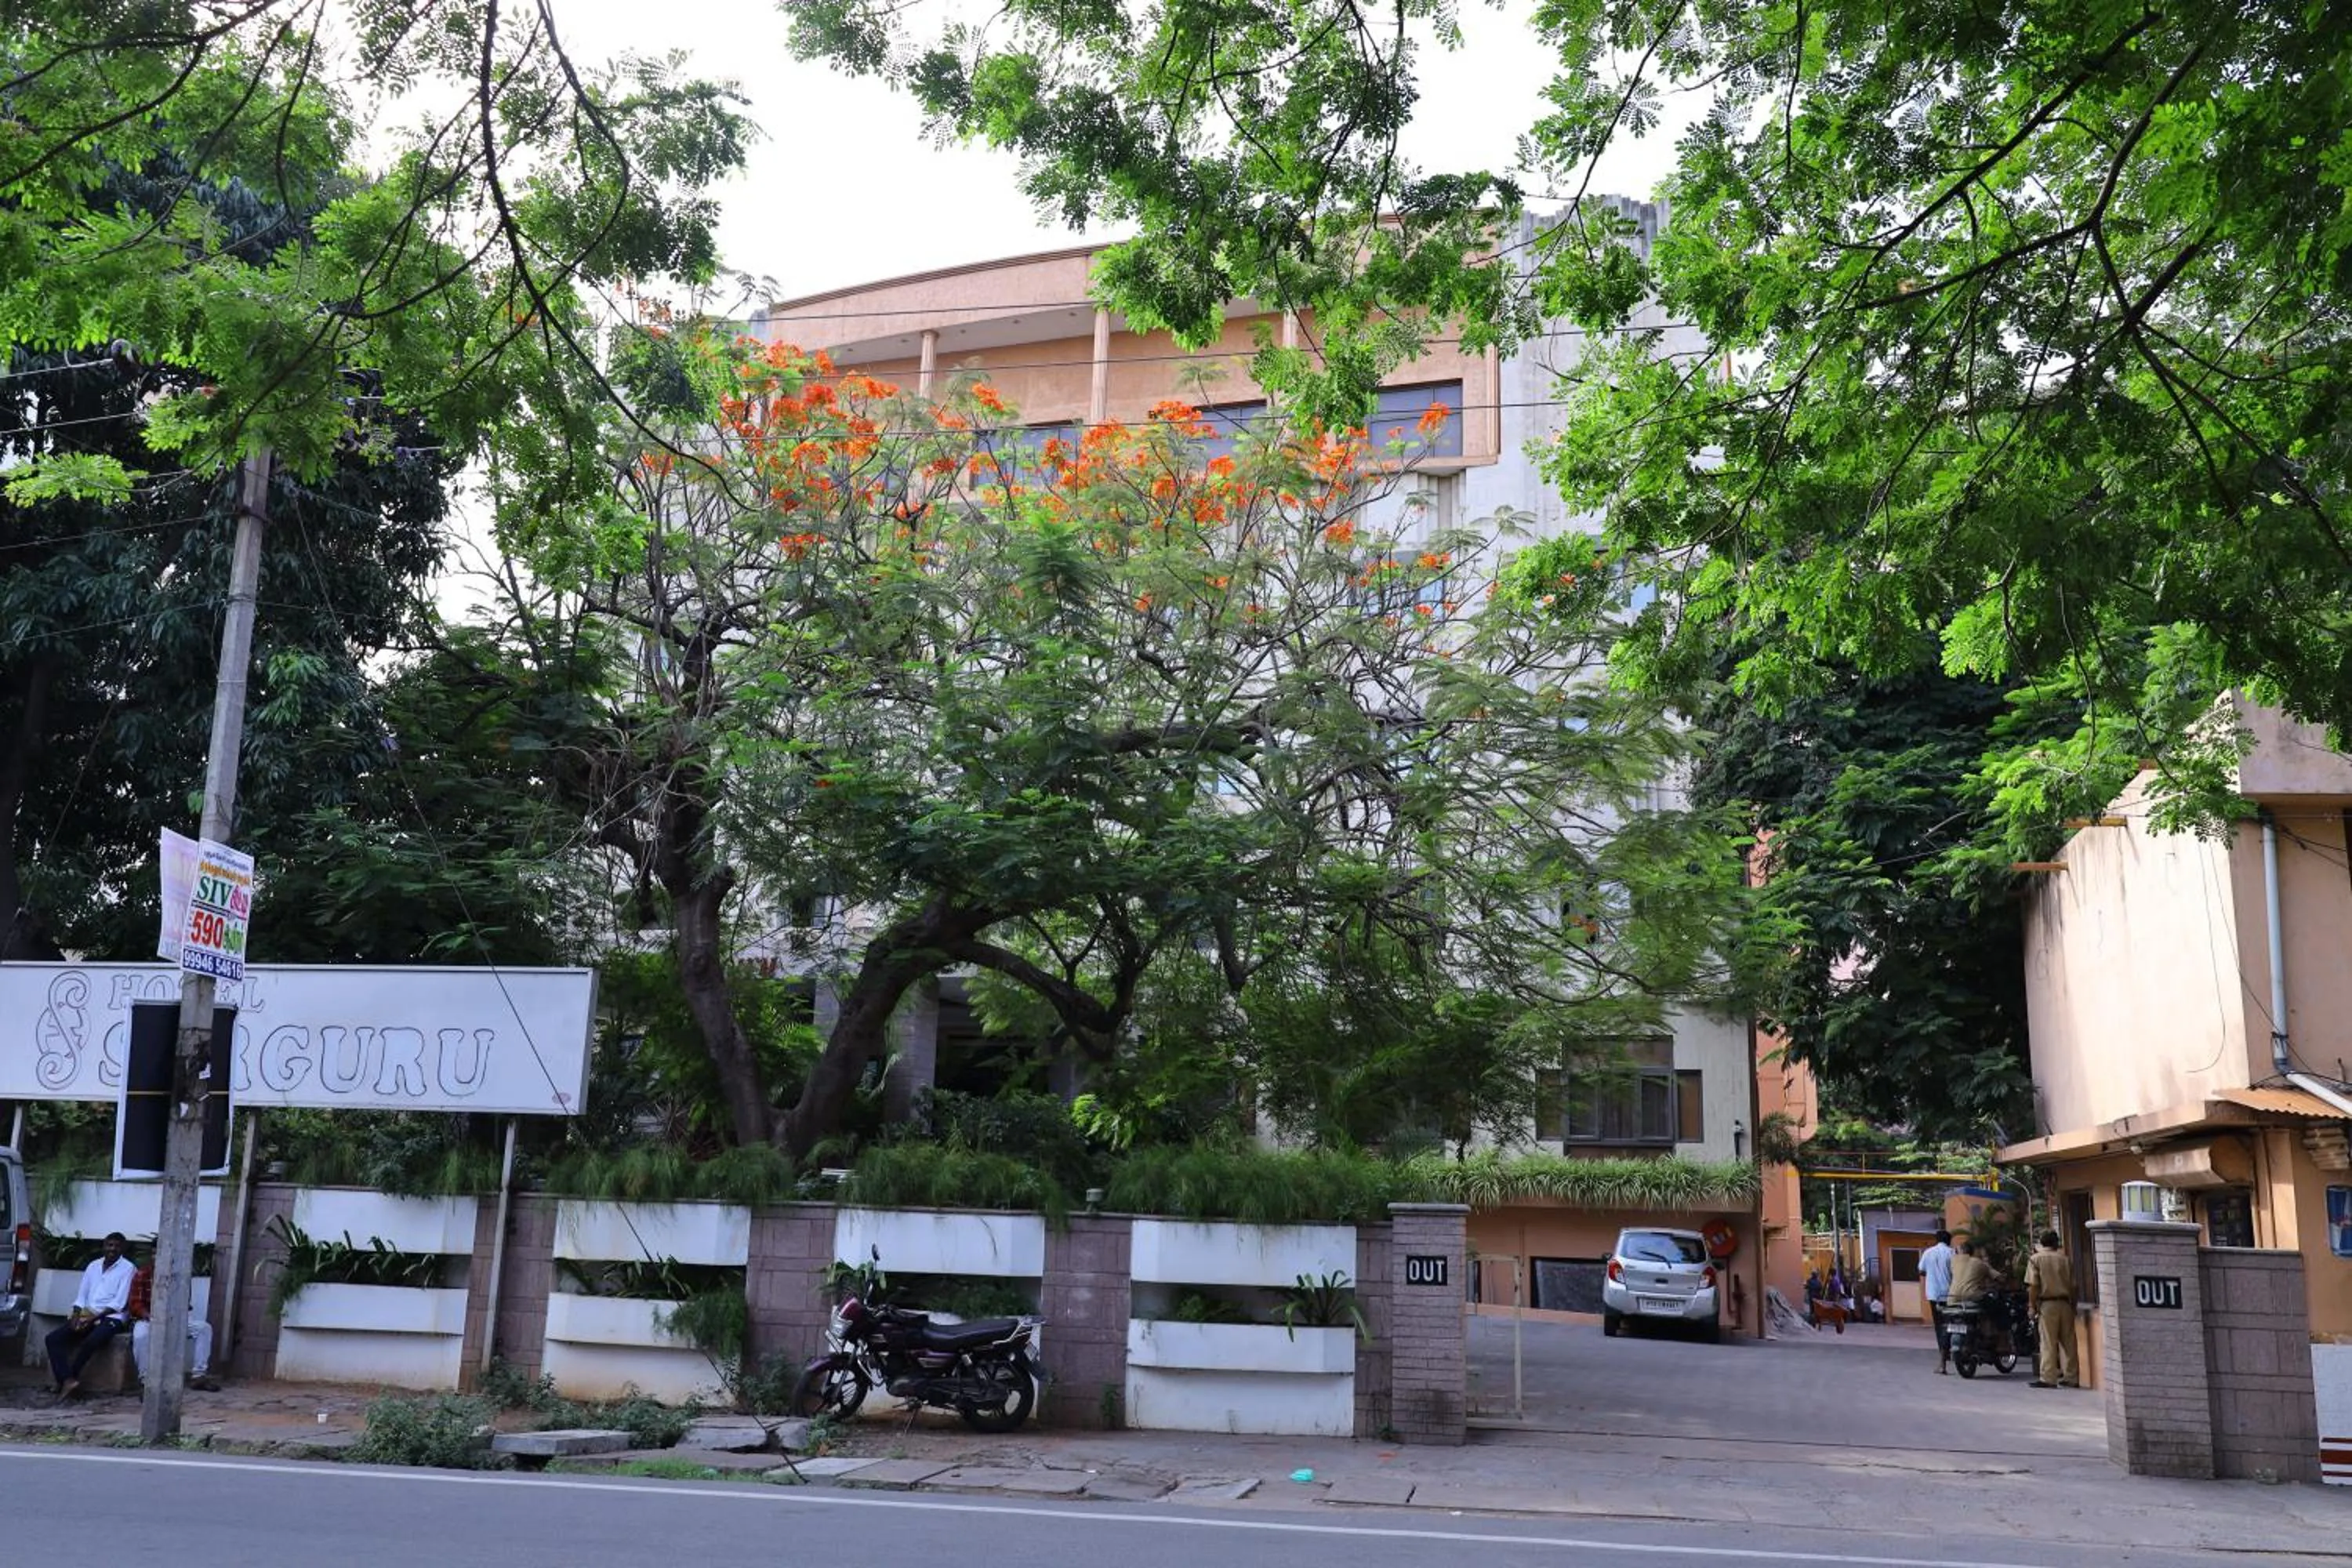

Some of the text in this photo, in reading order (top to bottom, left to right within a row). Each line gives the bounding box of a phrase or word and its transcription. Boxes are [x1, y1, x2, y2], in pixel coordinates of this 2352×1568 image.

[197, 876, 233, 906] SIV
[191, 910, 224, 949] 590
[109, 975, 265, 1013] HOEL
[1409, 1260, 1444, 1282] OUT
[2137, 1280, 2178, 1305] OUT
